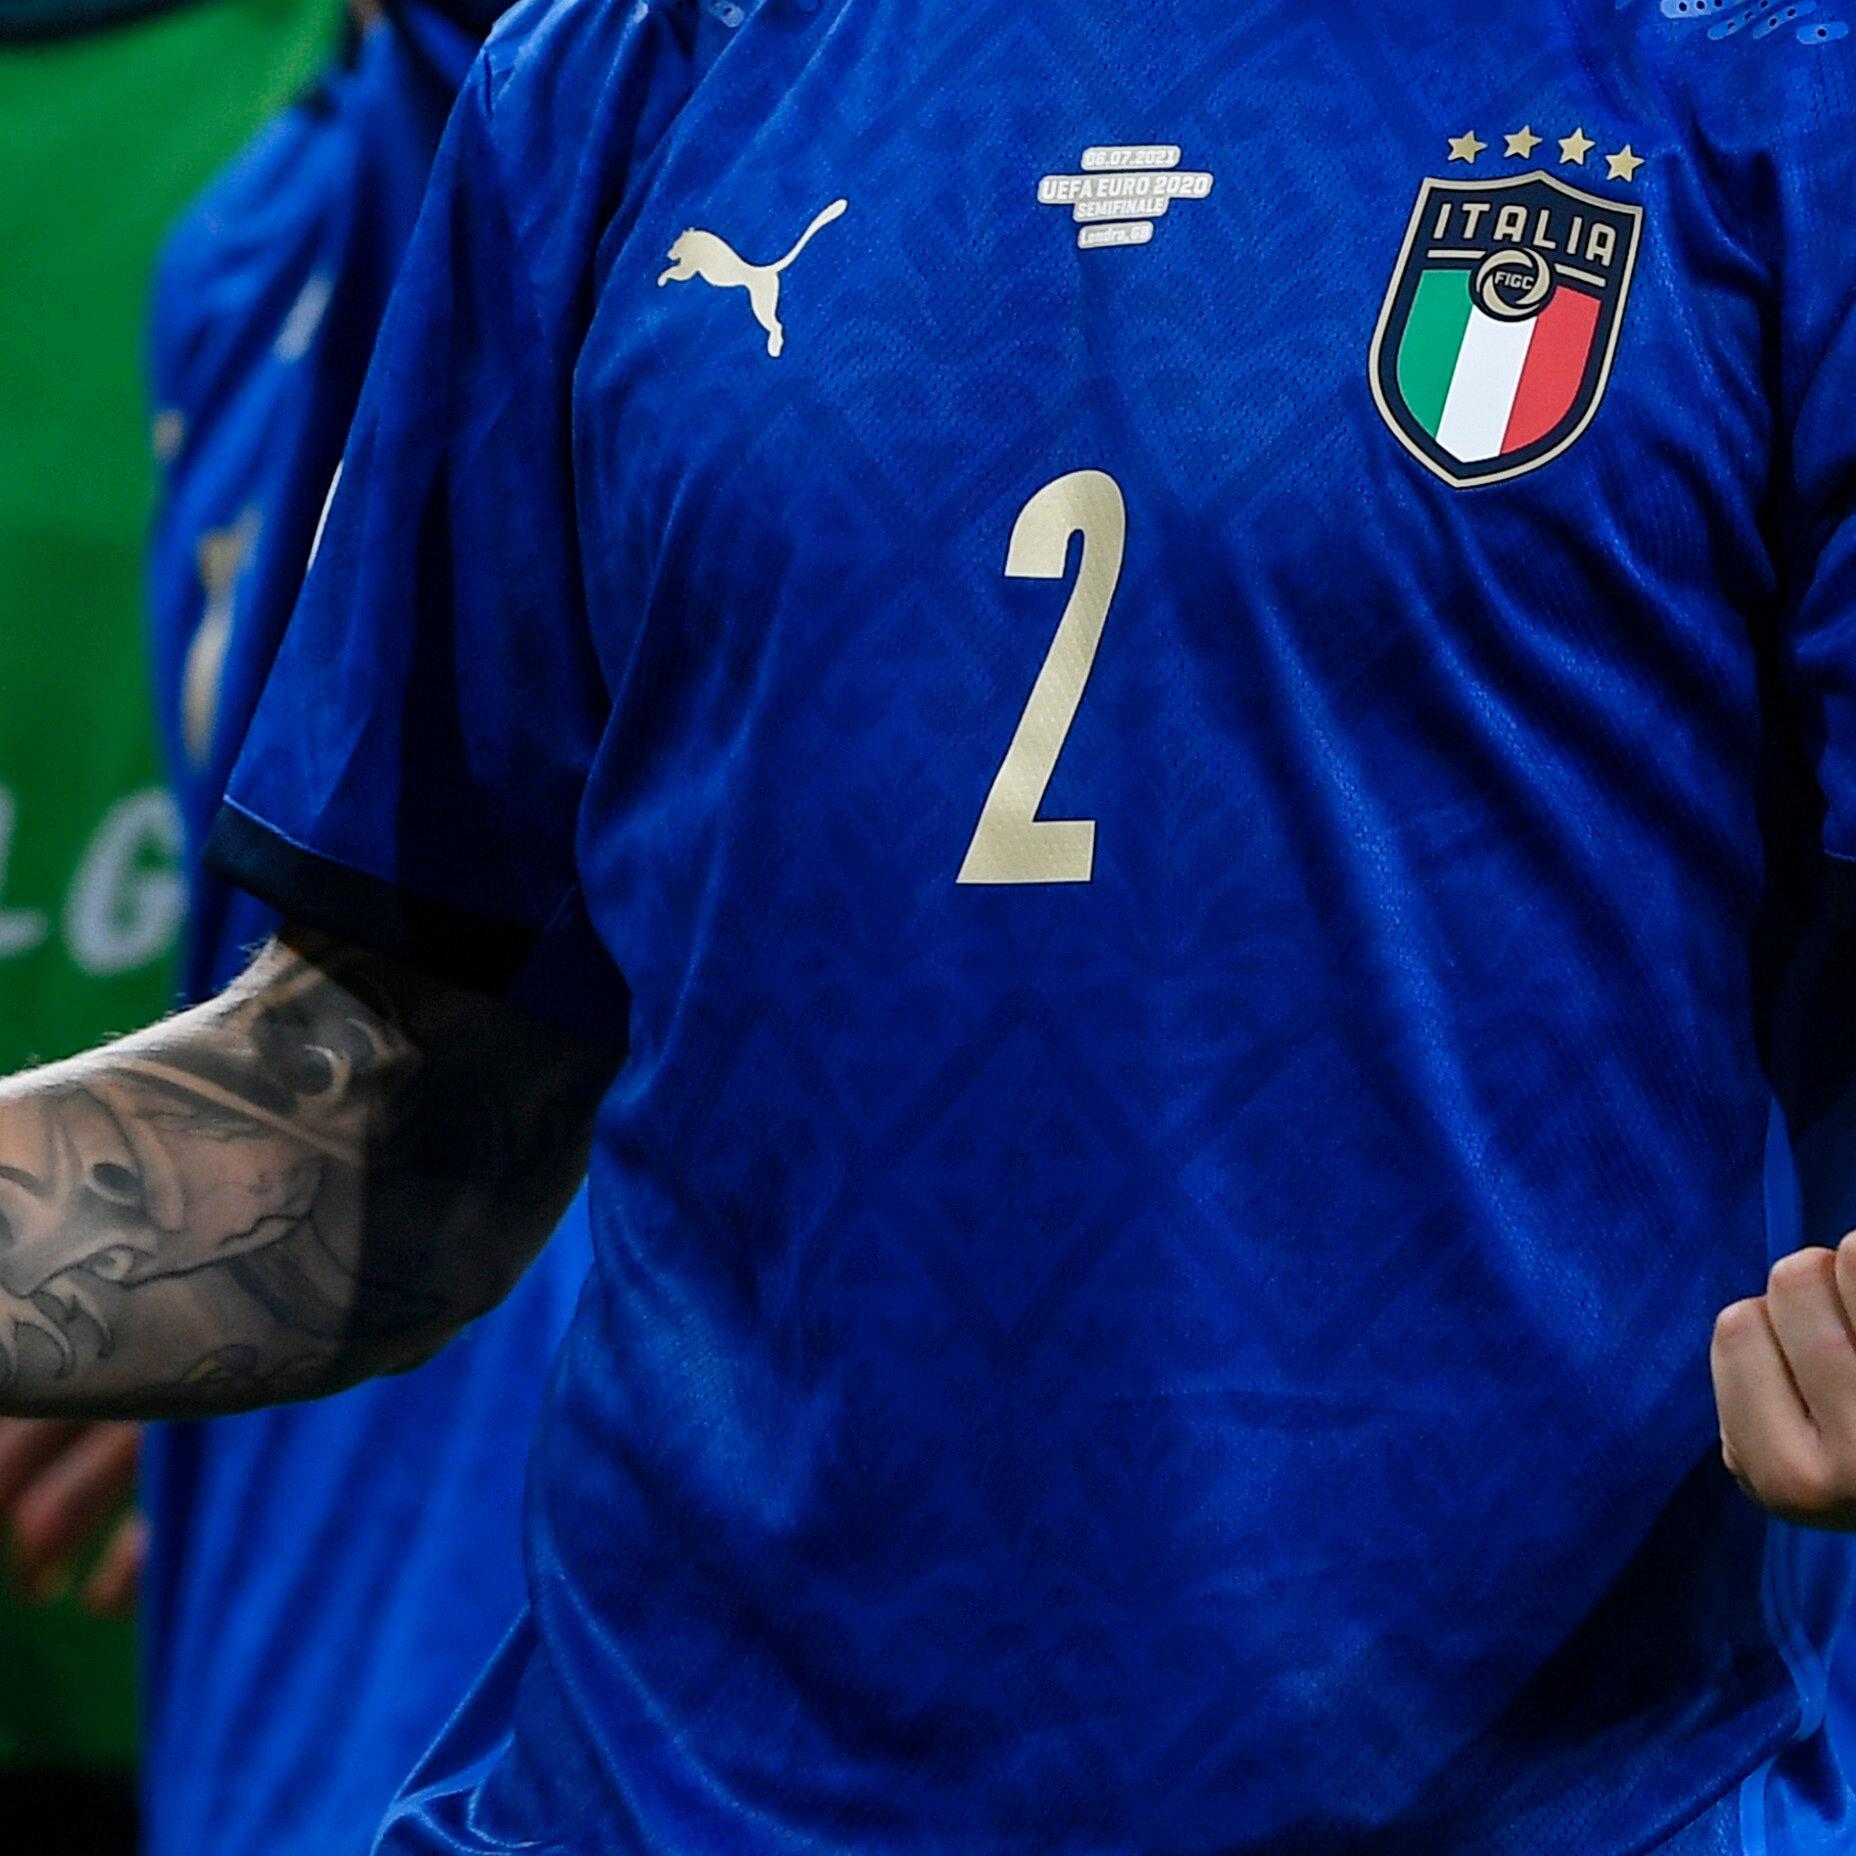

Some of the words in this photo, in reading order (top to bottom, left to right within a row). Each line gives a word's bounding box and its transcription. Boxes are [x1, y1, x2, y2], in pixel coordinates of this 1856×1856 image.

[1085, 150, 1177, 167] 06.07.2021
[1042, 179, 1093, 200] UEFA
[1097, 176, 1150, 197] EURO
[1153, 175, 1209, 195] 2020
[1077, 197, 1165, 218] SEMIFINALE
[1432, 202, 1617, 267] ITALIA
[1494, 270, 1535, 291] FIGC
[955, 468, 1127, 885] 2
